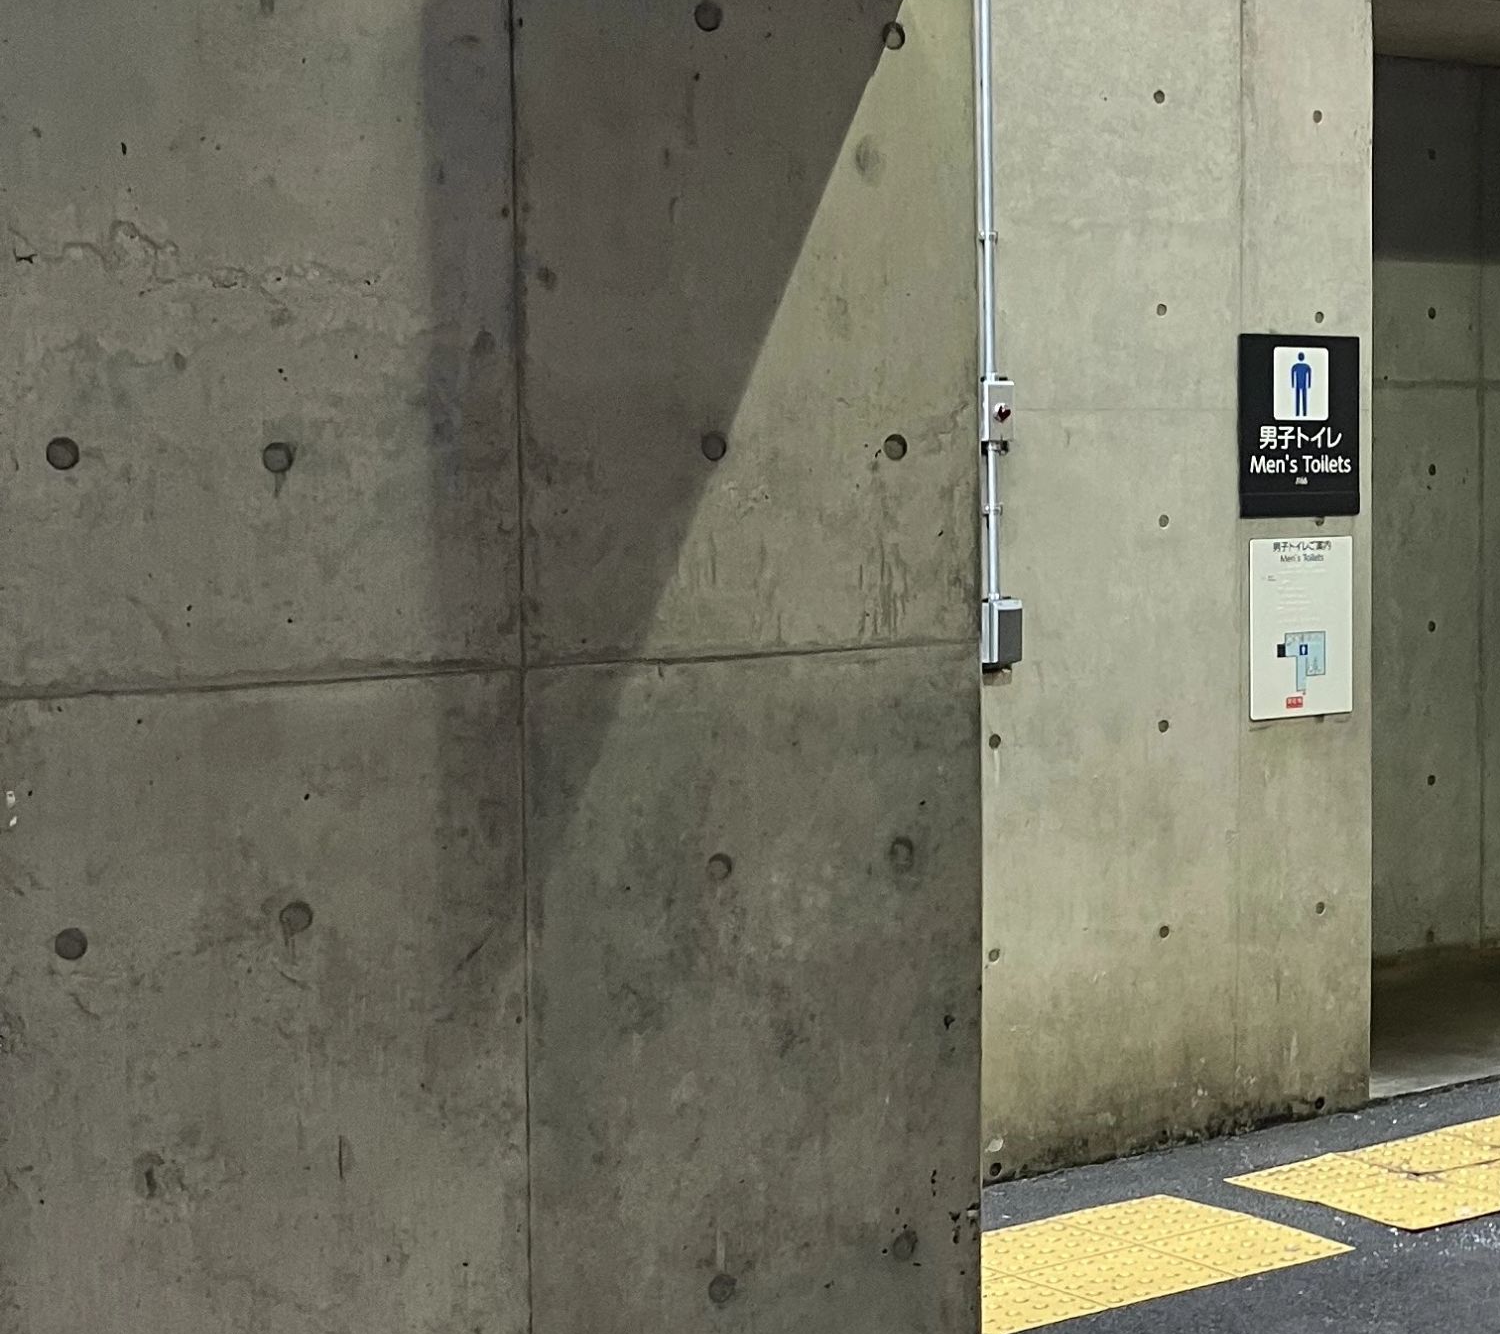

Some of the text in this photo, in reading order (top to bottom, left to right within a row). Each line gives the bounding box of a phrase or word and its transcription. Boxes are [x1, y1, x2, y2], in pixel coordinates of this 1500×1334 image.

[1259, 426, 1342, 449] 男子トイレ
[1250, 454, 1352, 474] Men's Toilets
